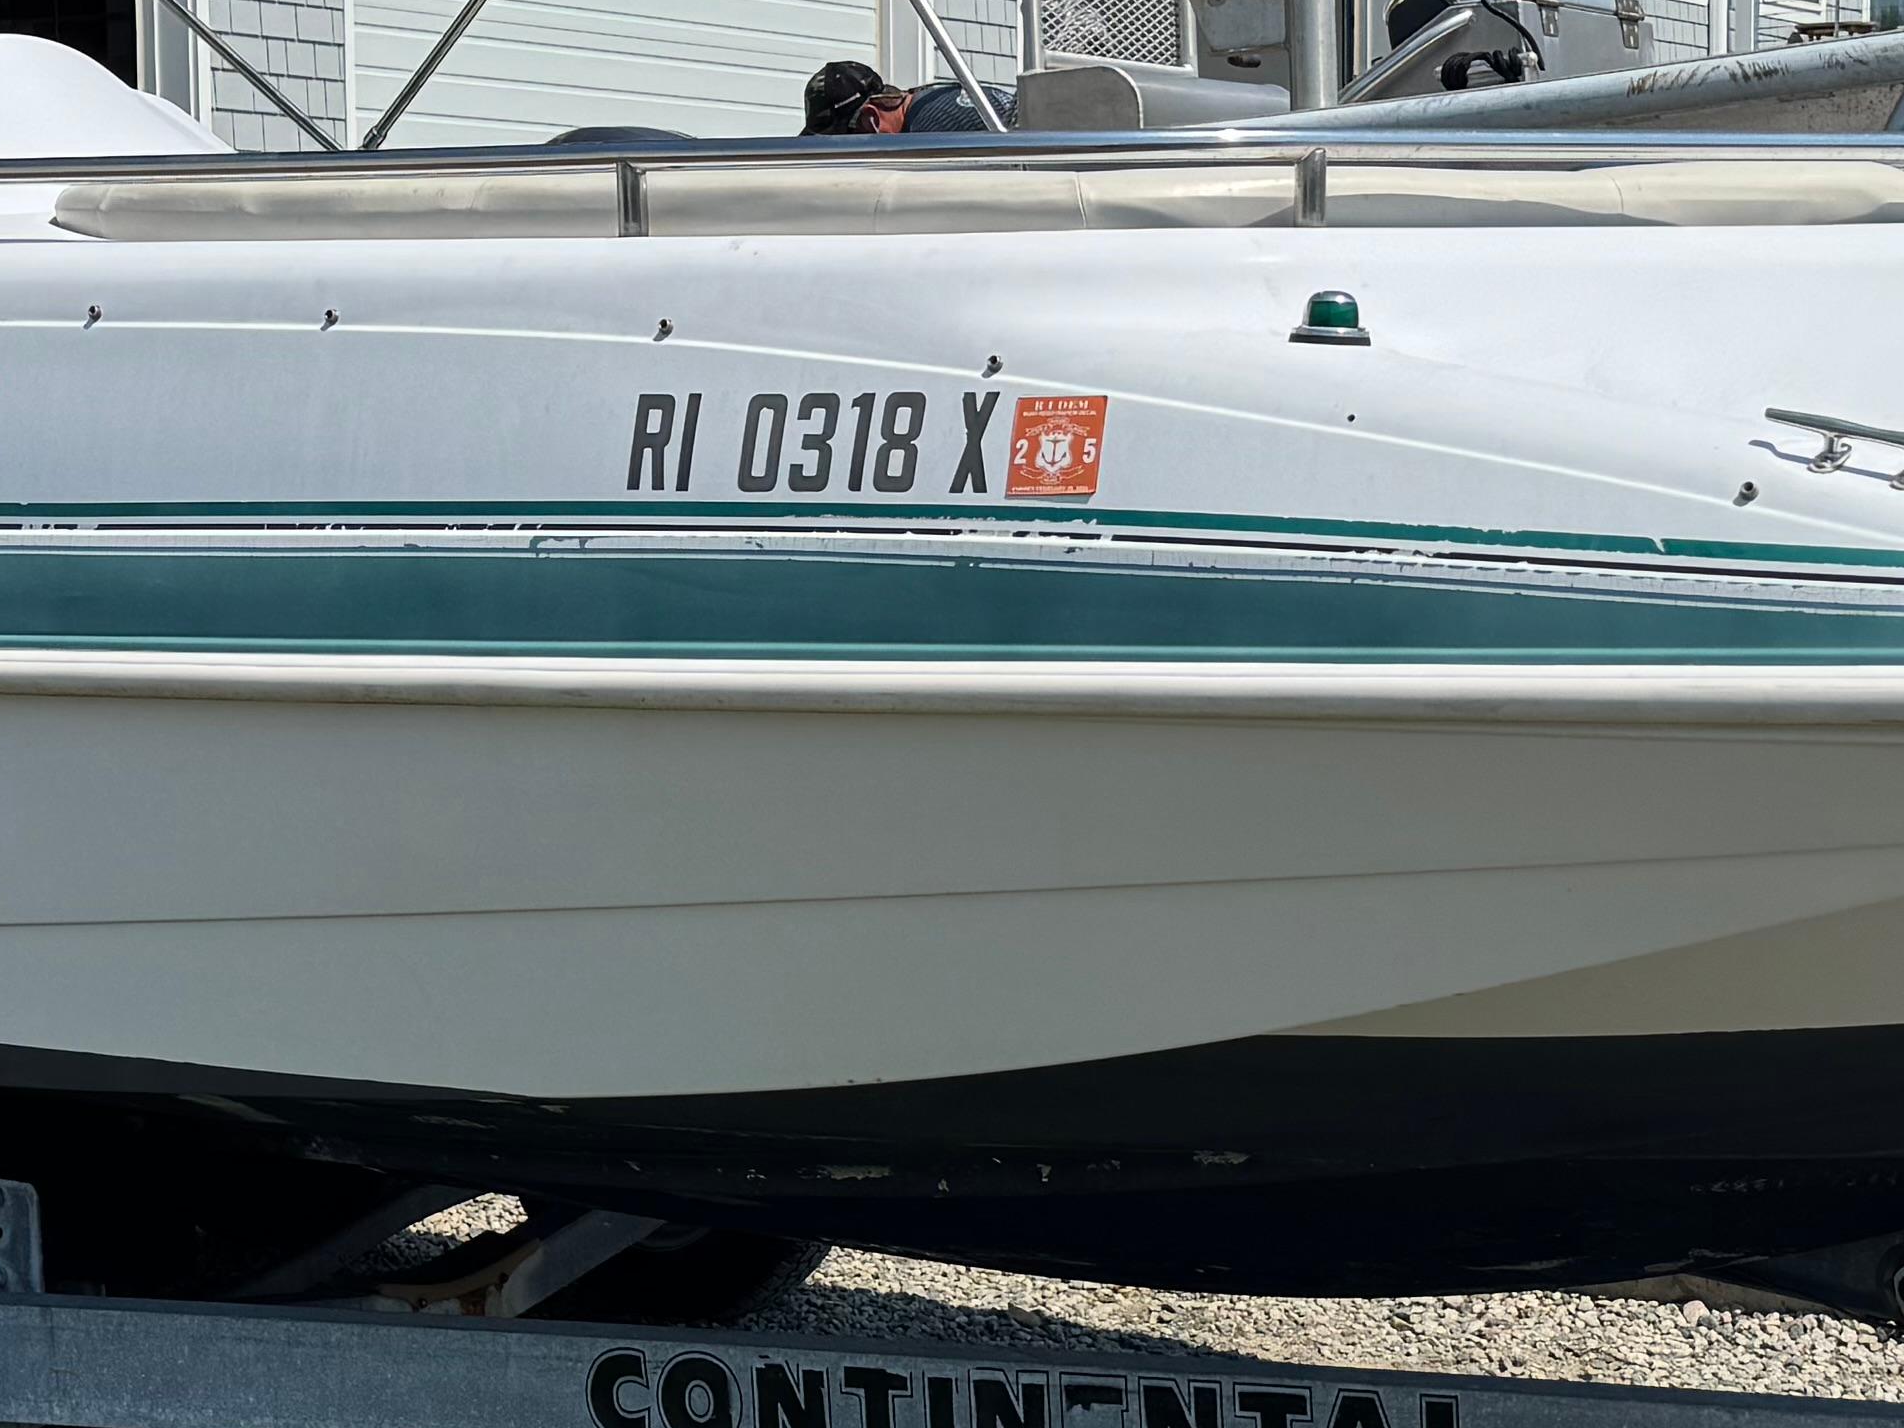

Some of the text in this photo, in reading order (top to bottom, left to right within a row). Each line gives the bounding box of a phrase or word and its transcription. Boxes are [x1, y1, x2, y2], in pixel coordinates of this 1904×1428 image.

[626, 391, 1001, 494] RI 0318 X
[1013, 437, 1097, 465] 2 5
